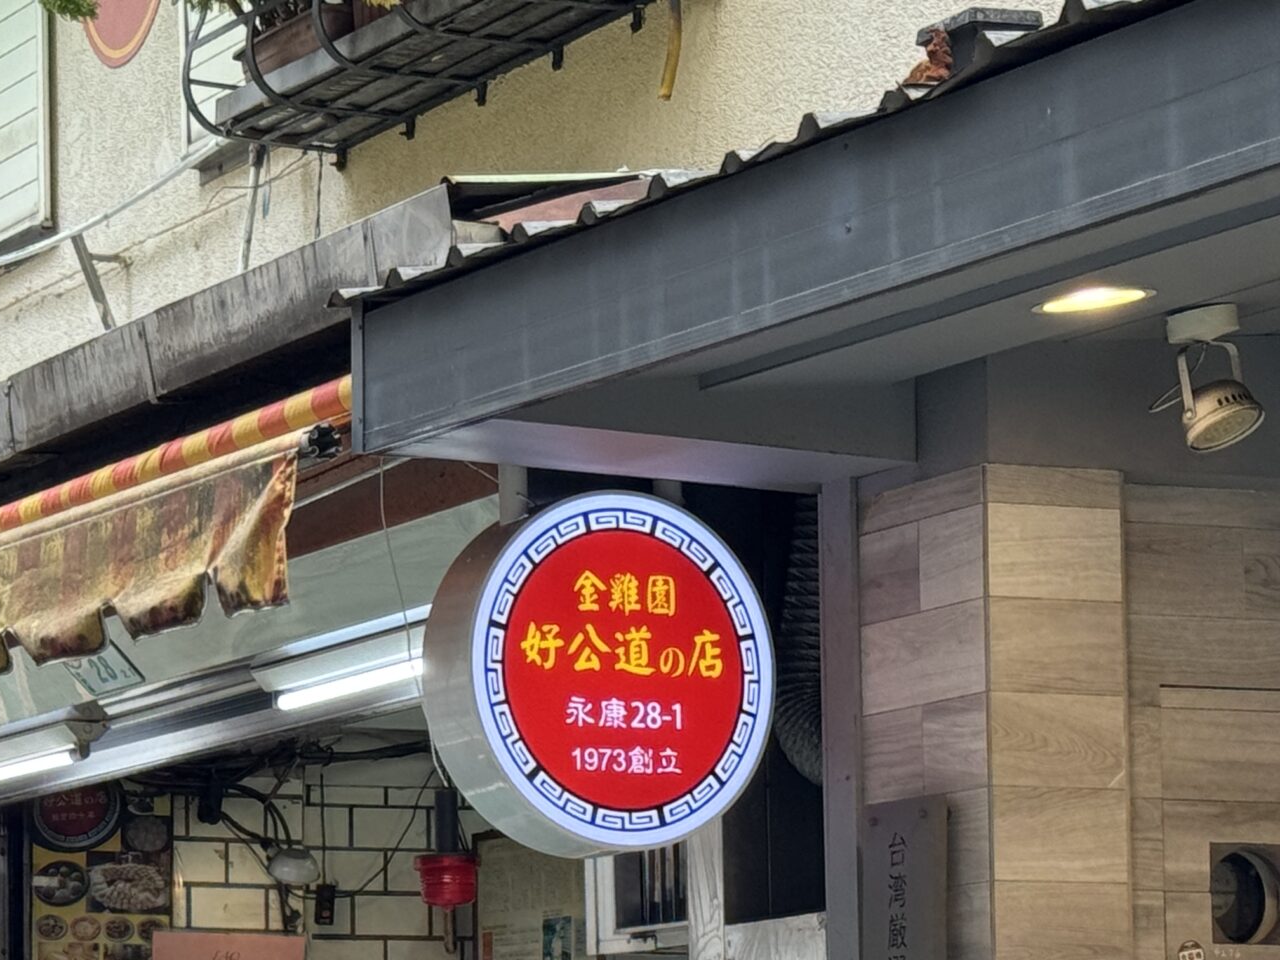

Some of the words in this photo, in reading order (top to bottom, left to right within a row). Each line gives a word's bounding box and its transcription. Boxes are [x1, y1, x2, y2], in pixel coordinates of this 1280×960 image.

[574, 570, 676, 617] 金雞園
[520, 622, 723, 678] 好公道の店
[566, 697, 683, 730] 永康28-1
[572, 748, 683, 775] 1973創立
